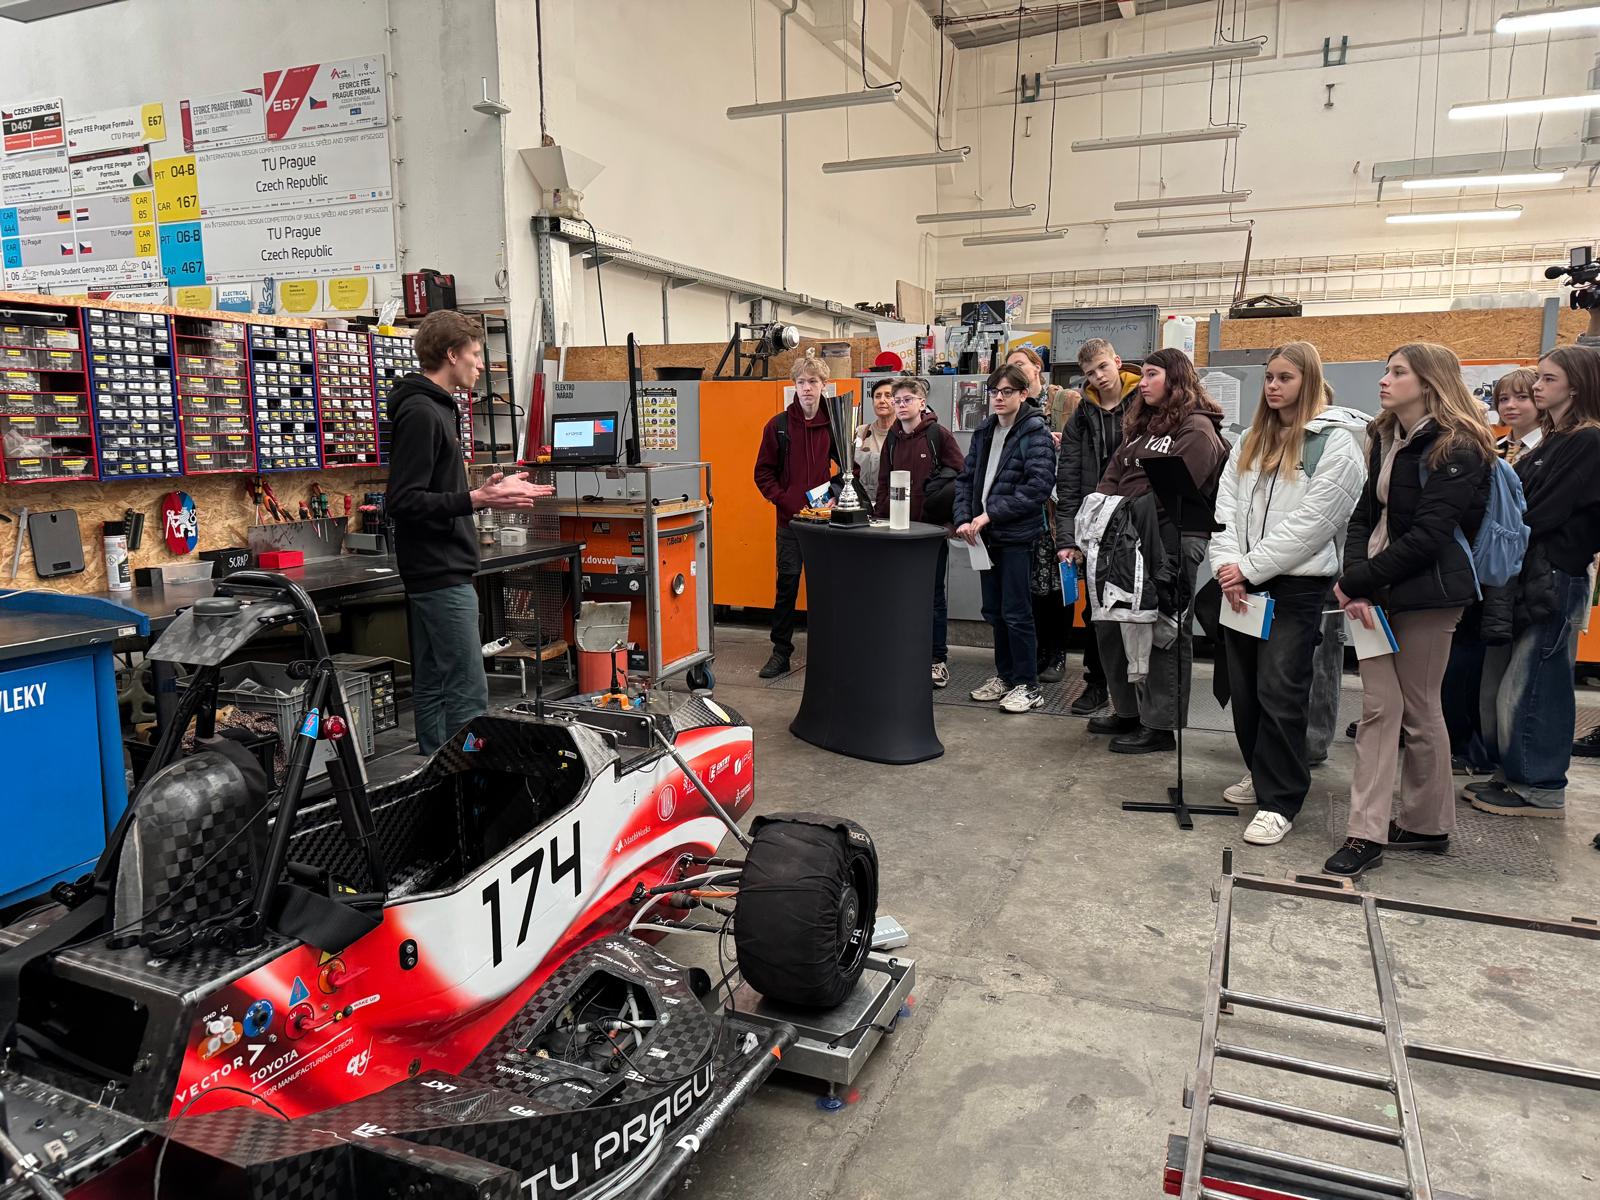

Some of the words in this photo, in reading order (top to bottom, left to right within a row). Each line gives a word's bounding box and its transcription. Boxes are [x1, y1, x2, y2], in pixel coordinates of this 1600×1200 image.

[339, 80, 359, 90] EFORCE
[360, 78, 371, 86] FEE
[332, 90, 354, 100] PRAGUE
[355, 86, 380, 96] FORMULA
[14, 106, 32, 116] CZECH
[33, 102, 60, 112] REPUBLIC
[211, 102, 229, 112] PRAGUE
[230, 98, 252, 109] FORMULA
[273, 97, 300, 112] E67
[11, 120, 32, 132] D467
[94, 123, 111, 131] Prague
[112, 120, 134, 128] Formula
[148, 116, 162, 126] E67
[262, 157, 276, 171] TU
[280, 155, 316, 170] Prague
[2, 172, 21, 180] EFORCE
[22, 169, 42, 177] PRAGUE
[43, 166, 68, 175] FORMULA
[155, 171, 165, 180] PIT
[171, 164, 195, 178] 04-B
[256, 179, 284, 192] Czech
[286, 173, 328, 190] Republic
[158, 202, 171, 211] CAR
[177, 195, 197, 208] 167
[138, 210, 147, 219] 85
[160, 235, 170, 244] PIT
[177, 229, 200, 243] 06-B
[267, 227, 281, 240] TU
[285, 226, 321, 240] Prague
[140, 244, 151, 252] 167
[261, 248, 288, 261] Czech
[292, 245, 333, 260] Republic
[8, 256, 18, 264] 467
[142, 261, 151, 270] 04
[40, 269, 60, 277] Formula
[82, 266, 105, 274] Germany
[163, 267, 176, 275] CAR
[182, 261, 202, 273] 467
[11, 272, 19, 280] 06
[555, 383, 574, 391] ELEKTRO
[228, 554, 248, 568] SCRAP
[0, 682, 47, 713] LEKY
[624, 825, 651, 846] MathWorks
[482, 820, 582, 968] 174
[850, 928, 862, 944] FR
[202, 1011, 217, 1023] GND
[221, 1004, 229, 1014] LV
[246, 1011, 254, 1019] AS
[290, 1012, 297, 1020] LV
[250, 1050, 299, 1084] TOYOTA
[251, 1084, 277, 1106] MOTOR
[278, 1052, 333, 1090] MANUFACTURING
[333, 1037, 354, 1053] CZECH
[176, 1056, 244, 1102] VECTOR
[696, 1110, 722, 1134] Digiteq
[717, 1076, 749, 1111] Automotive
[521, 1152, 578, 1200] TU
